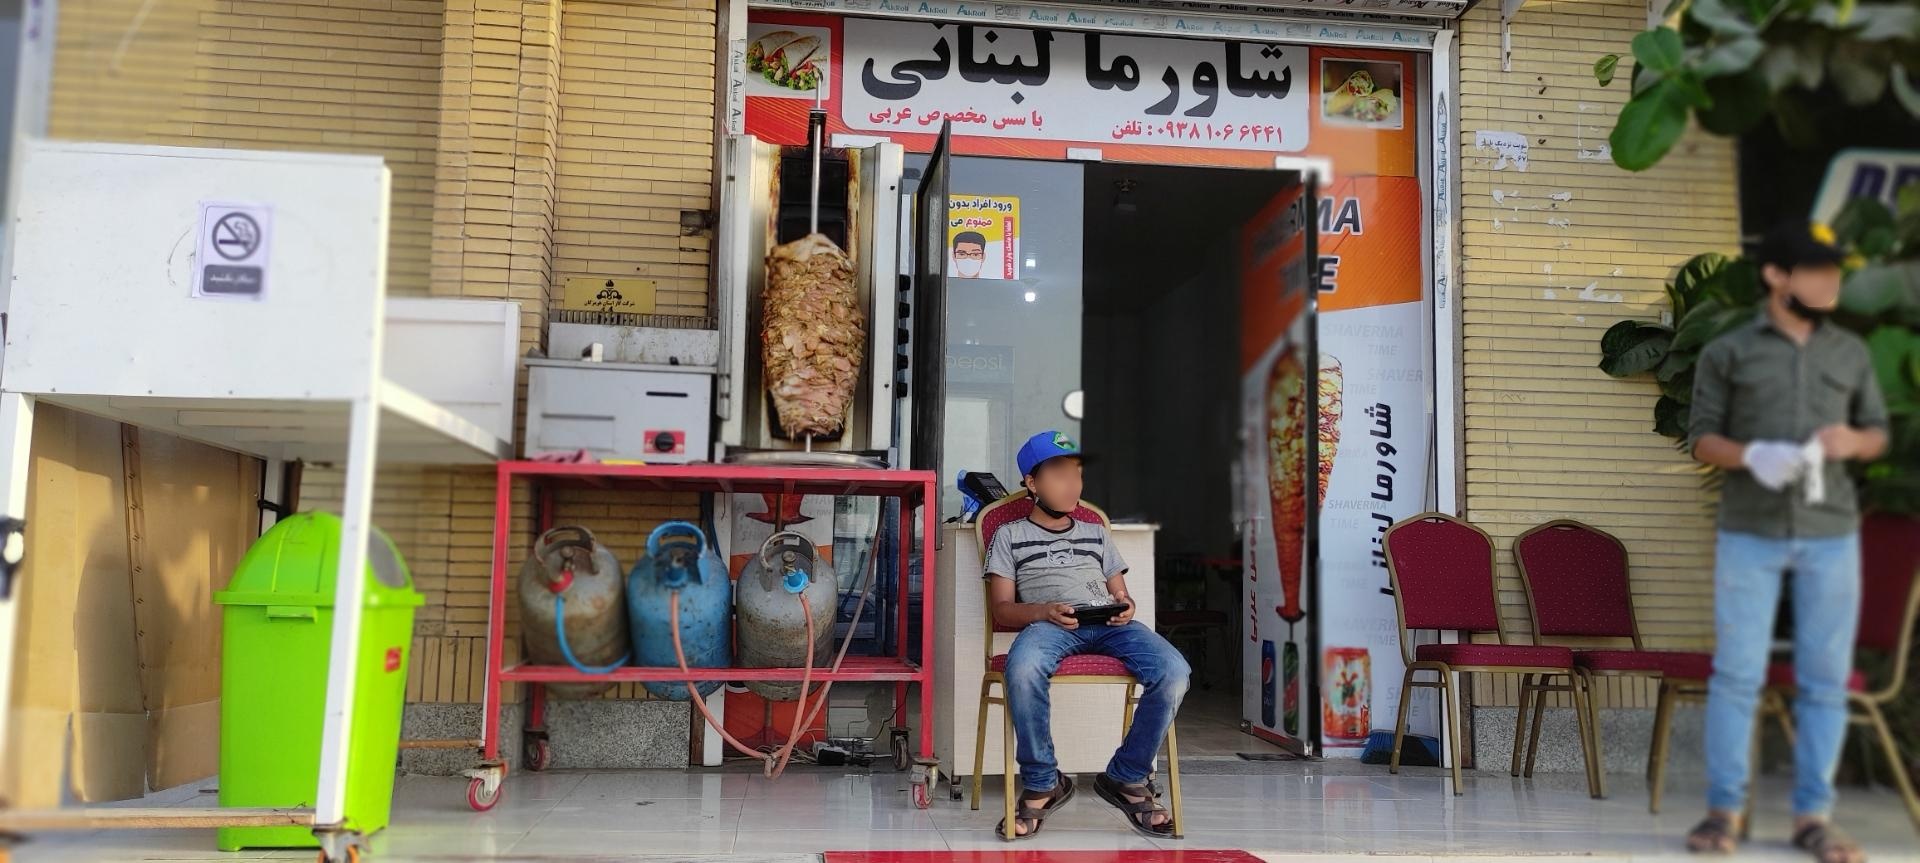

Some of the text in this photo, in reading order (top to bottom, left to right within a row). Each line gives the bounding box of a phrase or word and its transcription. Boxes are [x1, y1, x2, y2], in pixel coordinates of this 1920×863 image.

[862, 22, 1292, 118] شاورما لبنانی
[869, 106, 1043, 131] با سس مخصوص عربی
[1111, 120, 1142, 140] تلفن
[1157, 120, 1201, 140] ۰۹۳۸
[1206, 122, 1234, 141] ۱۰۶
[1239, 124, 1283, 144] ۶۴۴۱
[948, 198, 1012, 212] ورود افراد بدون
[950, 217, 993, 228] ممنوع می
[1364, 402, 1398, 502] شاورما
[1328, 500, 1387, 511] SHAVERMA
